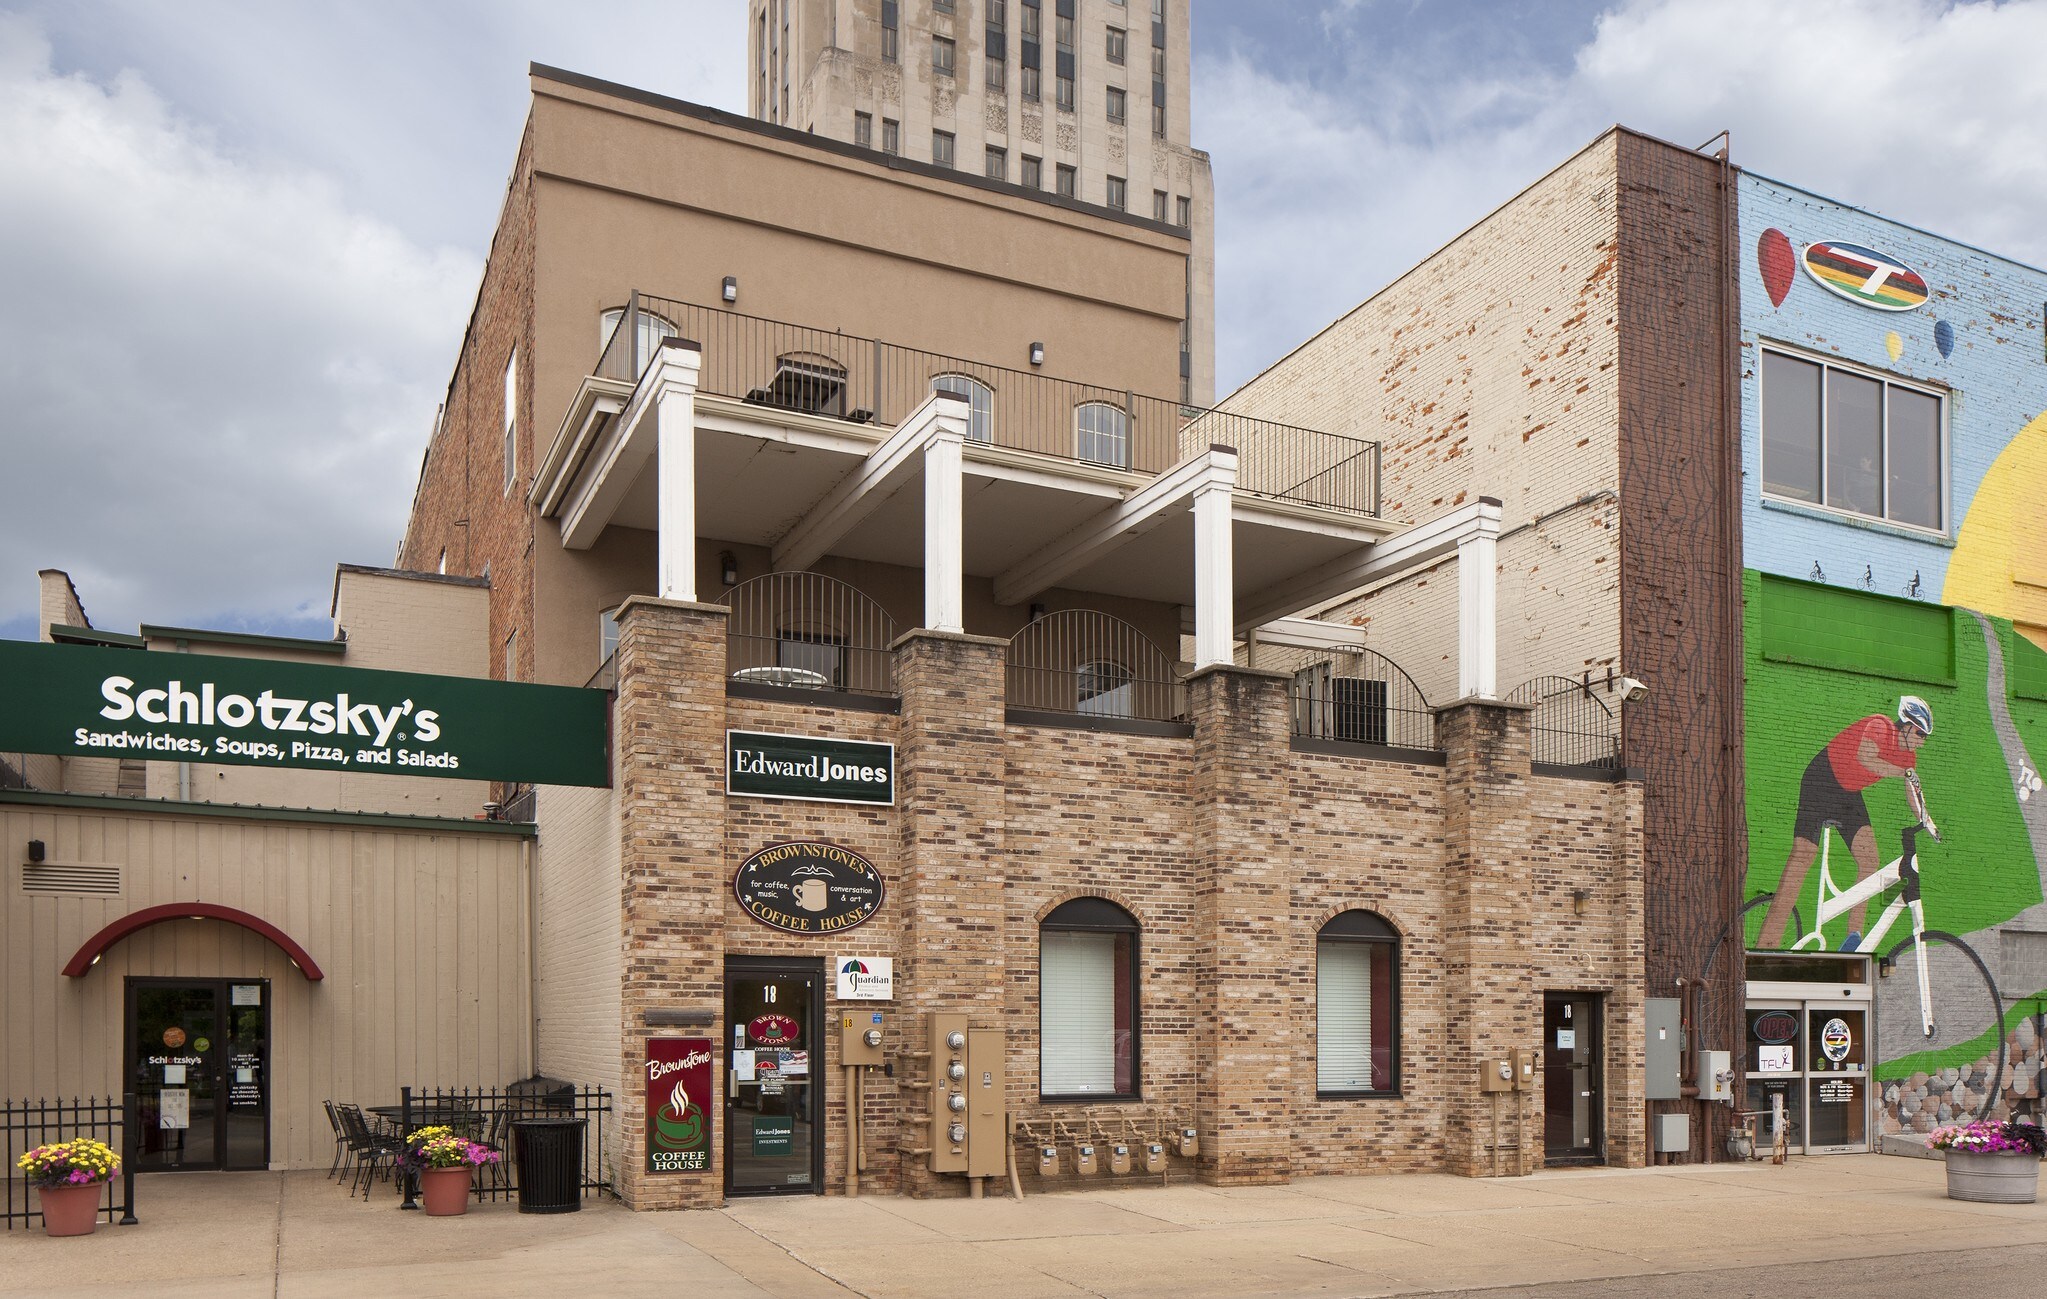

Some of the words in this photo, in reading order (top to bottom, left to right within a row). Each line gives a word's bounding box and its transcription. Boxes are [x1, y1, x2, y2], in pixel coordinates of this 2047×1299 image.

[1828, 246, 1907, 296] T
[99, 675, 441, 747] Schlotzsky's
[75, 728, 209, 756] Sandwiches,
[216, 737, 286, 761] Soups,
[292, 742, 350, 765] Pizza,
[356, 747, 391, 765] and
[397, 750, 459, 769] Salads
[758, 844, 867, 874] BROWNSTONES
[751, 880, 762, 888] for
[764, 880, 790, 891] coffee,
[830, 885, 873, 895] conversation
[757, 890, 779, 899] music,
[840, 894, 847, 902] &
[849, 895, 862, 903] art
[751, 901, 810, 931] COFFEE
[820, 907, 867, 931] HOUSE
[763, 985, 777, 1003] 18
[1564, 1004, 1572, 1019] 18
[844, 1018, 853, 1028] 18
[1759, 1017, 1793, 1039] OPEN
[149, 1056, 202, 1065] Schlotzsky's
[645, 1049, 711, 1081] Brownstone
[652, 1151, 706, 1162] COFFEE
[655, 1161, 703, 1171] HOUSE
